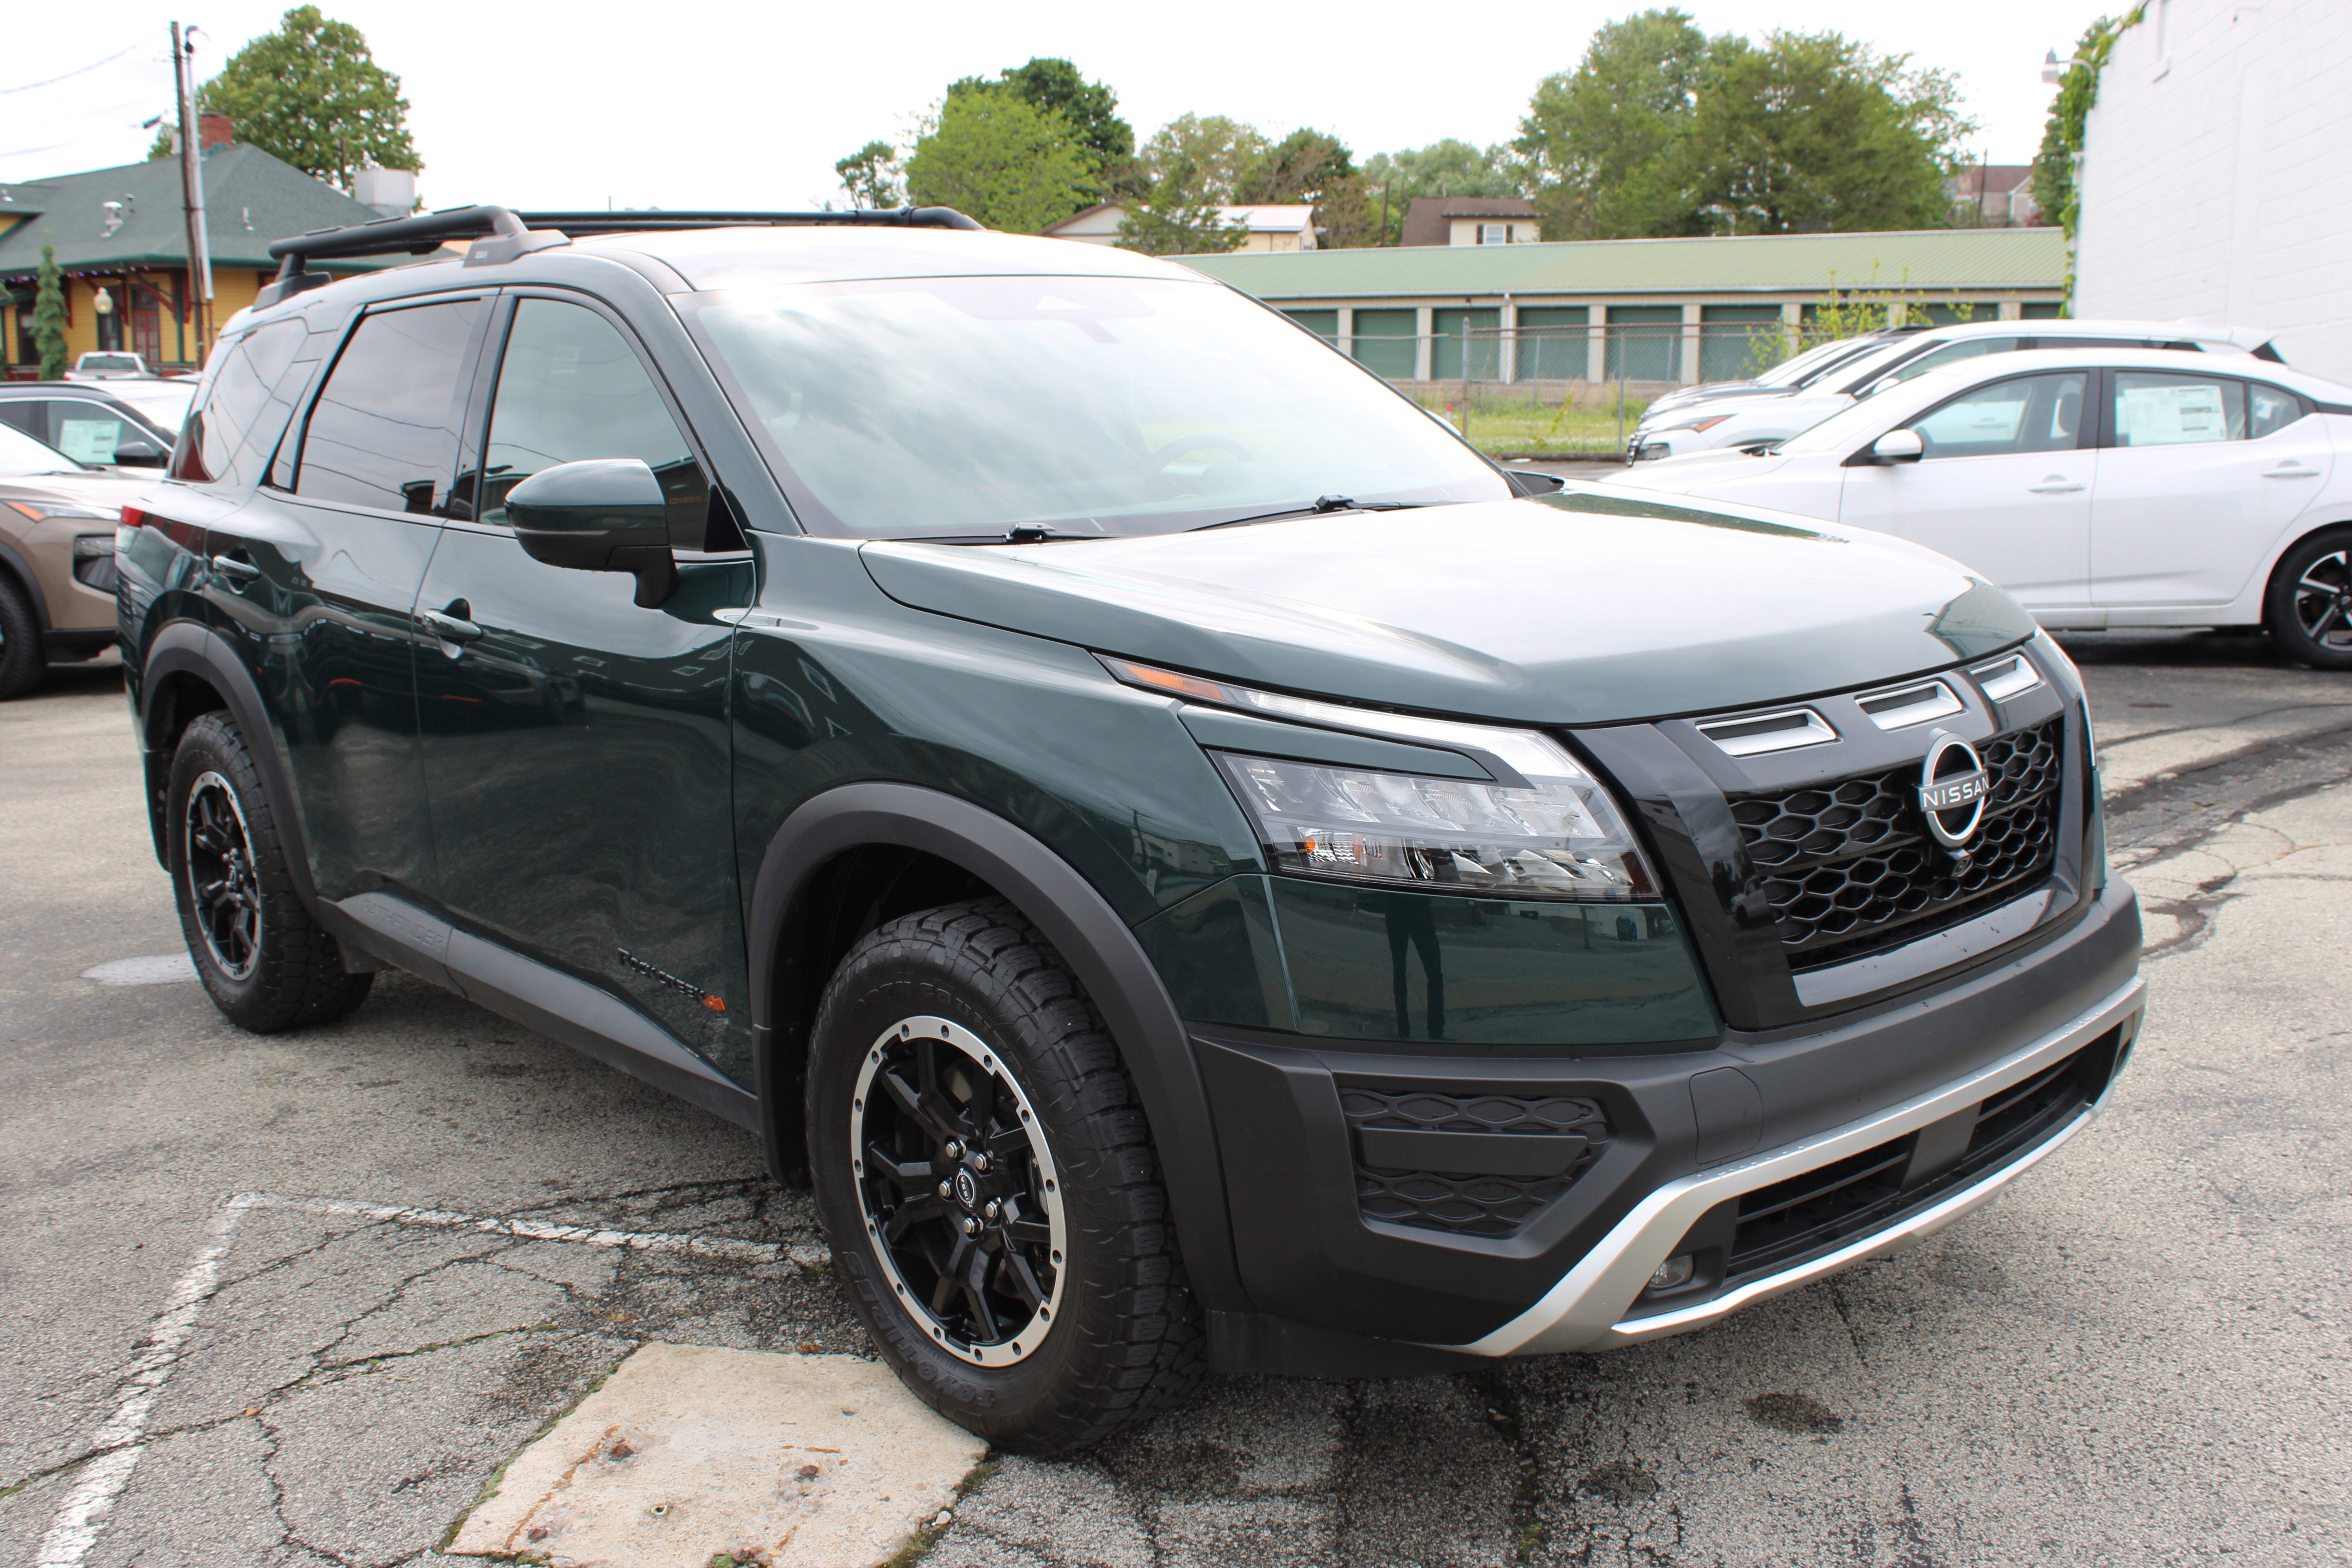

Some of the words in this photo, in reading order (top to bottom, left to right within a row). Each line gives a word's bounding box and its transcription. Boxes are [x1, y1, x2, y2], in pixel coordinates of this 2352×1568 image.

[1922, 775, 1989, 808] NISSAN
[361, 899, 445, 952] PATHFINDER
[618, 947, 657, 981] ROCK
[658, 970, 706, 1001] CREEK
[959, 1168, 973, 1208] NISSAN
[842, 1251, 917, 1362] TIRES
[915, 1360, 995, 1408] TOYO
